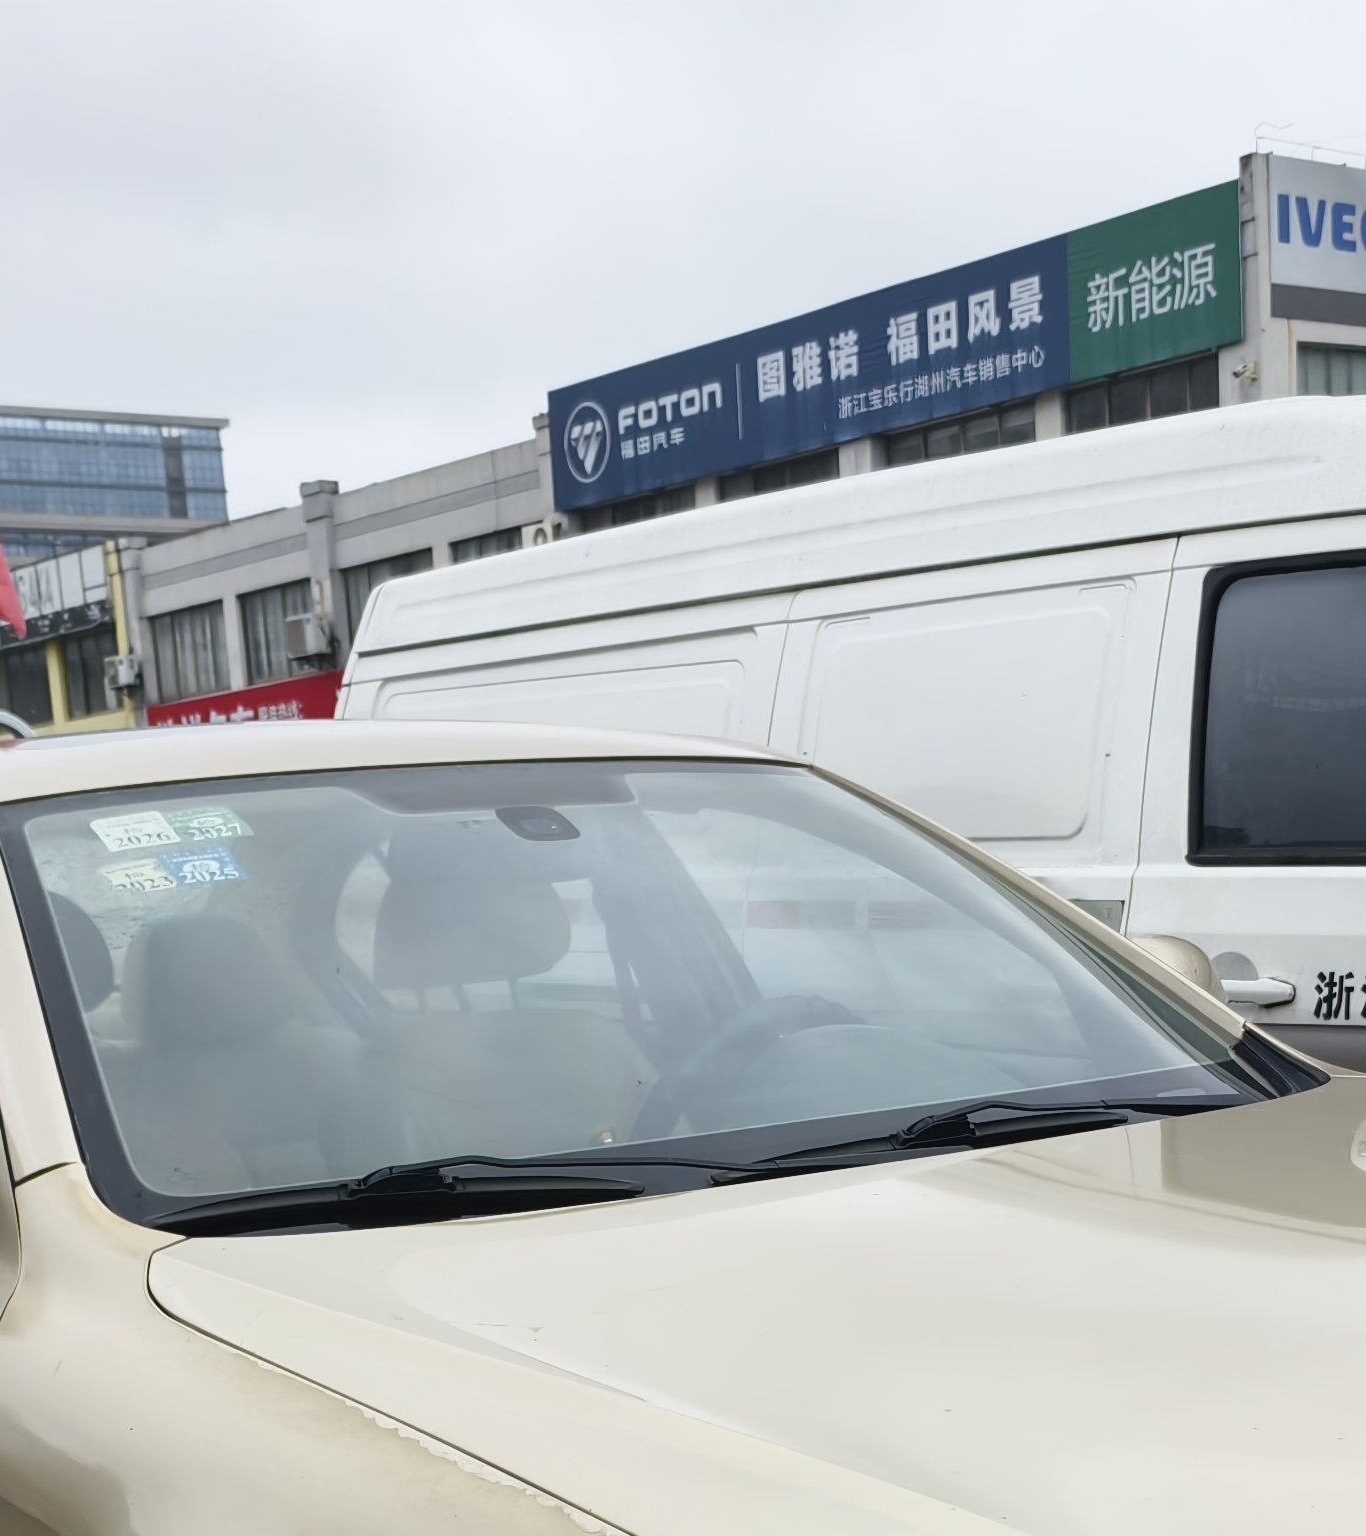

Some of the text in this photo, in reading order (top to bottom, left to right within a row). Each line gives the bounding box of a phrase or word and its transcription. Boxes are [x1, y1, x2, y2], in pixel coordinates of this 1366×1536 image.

[1086, 243, 1217, 333] 新能源
[756, 275, 1044, 402] 图雅诺 福田风景
[838, 345, 1046, 419] 浙江宝乐行湖州汽车销售中心
[618, 382, 723, 435] FOTON
[620, 427, 685, 460] 福田汽车
[112, 831, 171, 849] 2026
[187, 822, 243, 841] 2027
[178, 867, 240, 884] 2025
